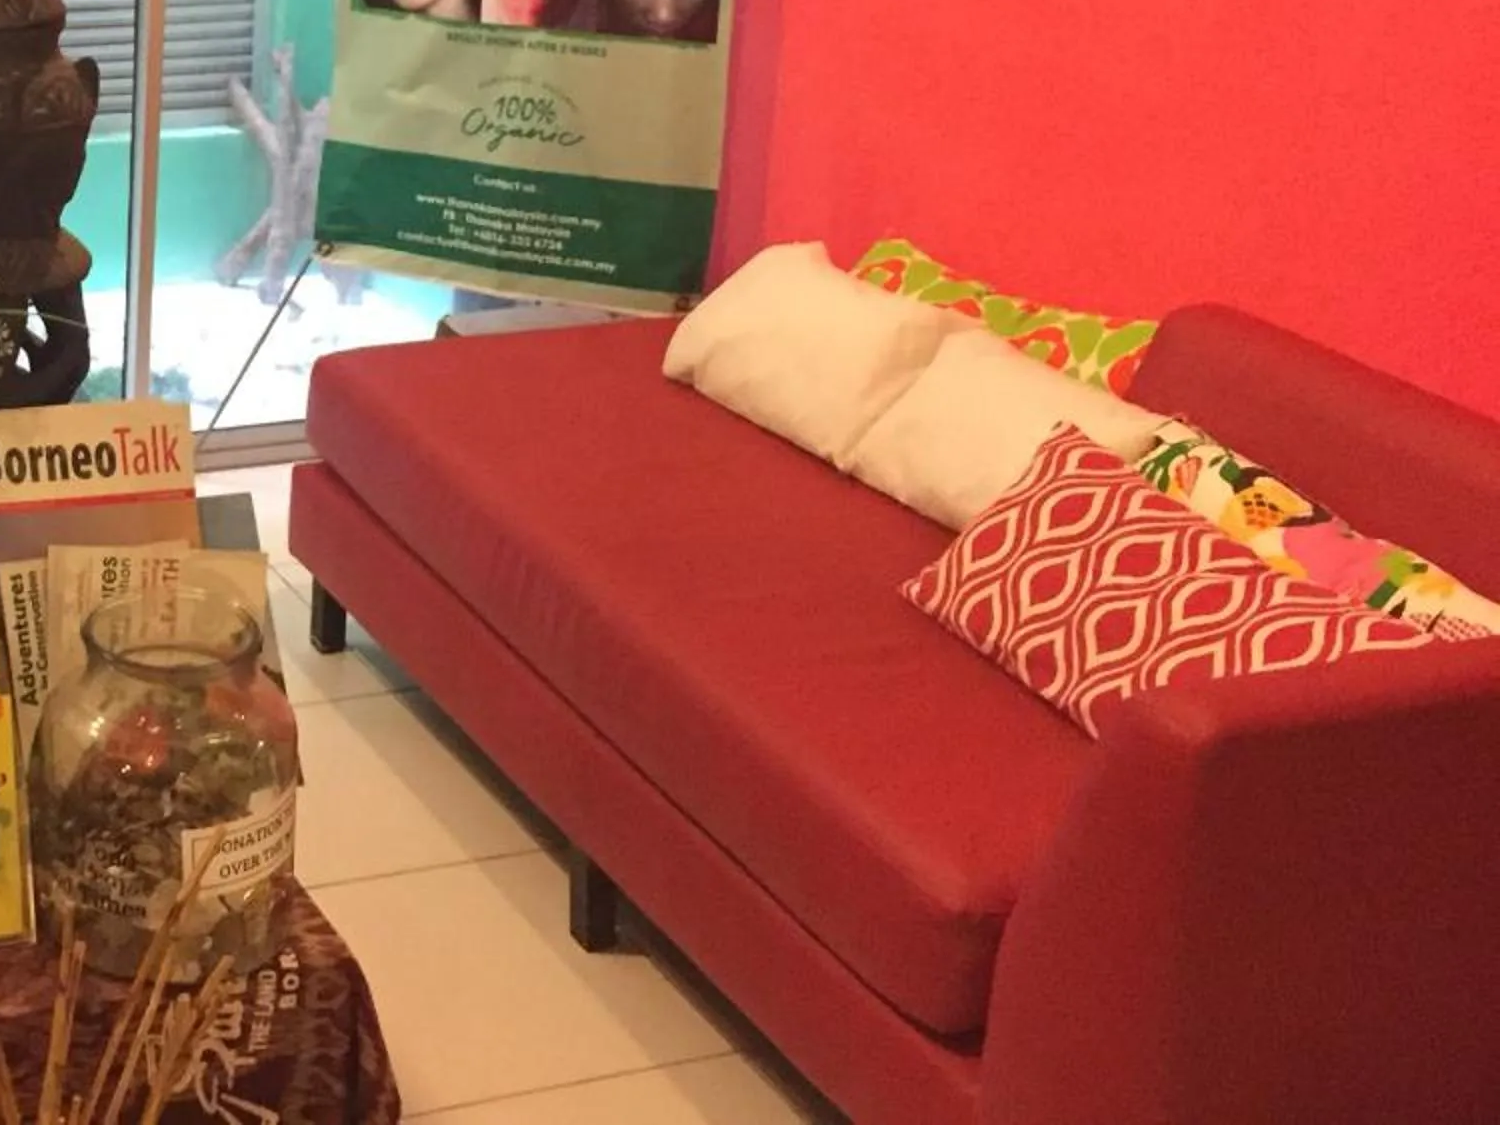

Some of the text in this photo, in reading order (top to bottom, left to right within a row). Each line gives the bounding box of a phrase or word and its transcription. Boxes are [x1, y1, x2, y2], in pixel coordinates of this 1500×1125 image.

[495, 95, 557, 124] 100%
[460, 106, 585, 153] Organic
[9, 572, 39, 707] Adventures
[219, 853, 261, 879] OVER
